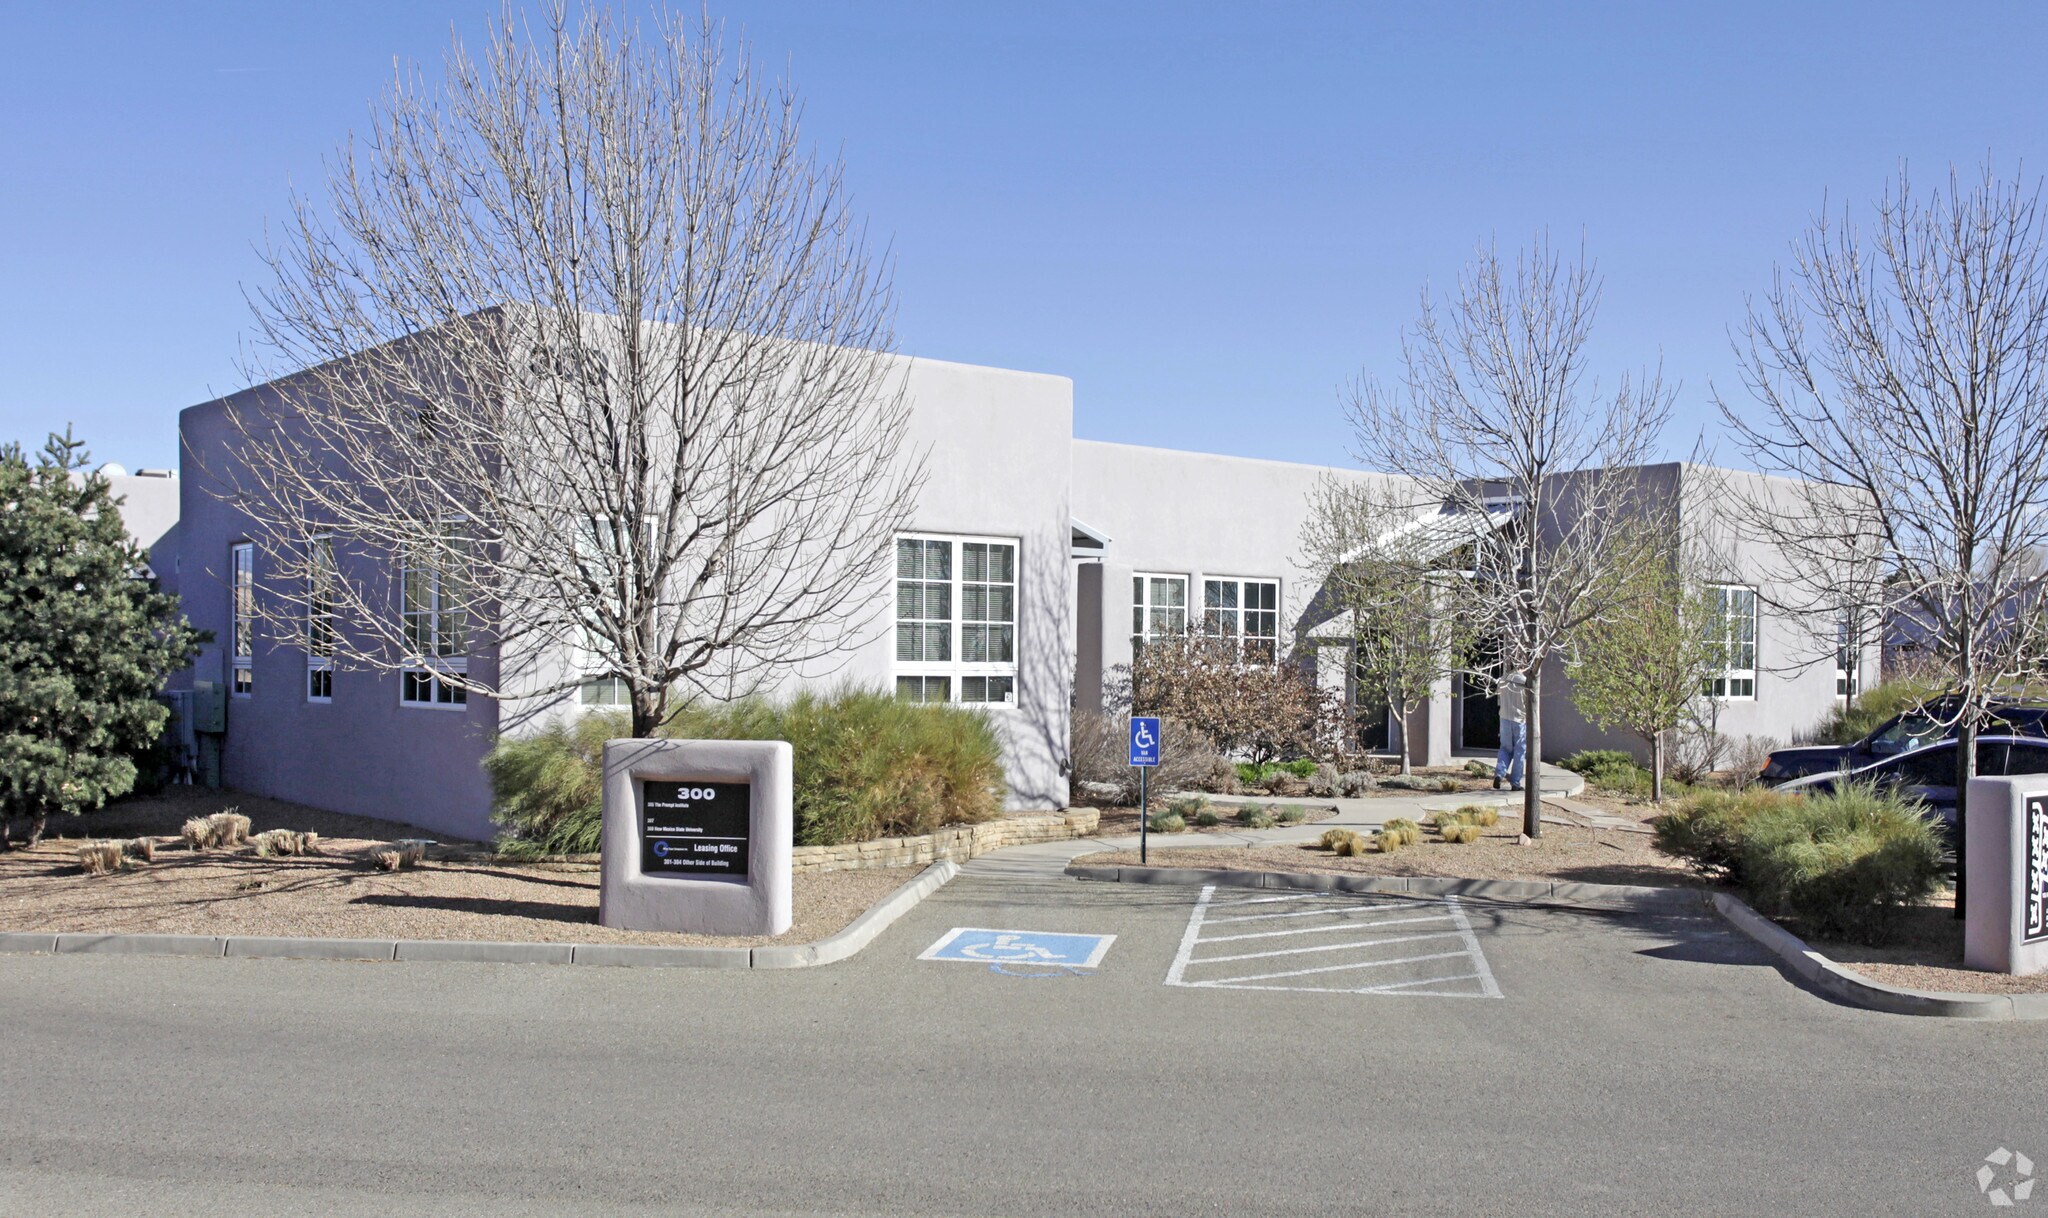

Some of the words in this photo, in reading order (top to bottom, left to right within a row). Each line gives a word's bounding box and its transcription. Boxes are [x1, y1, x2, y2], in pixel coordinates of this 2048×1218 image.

[677, 787, 716, 800] 300
[694, 844, 718, 854] Leasing
[719, 844, 738, 853] Office
